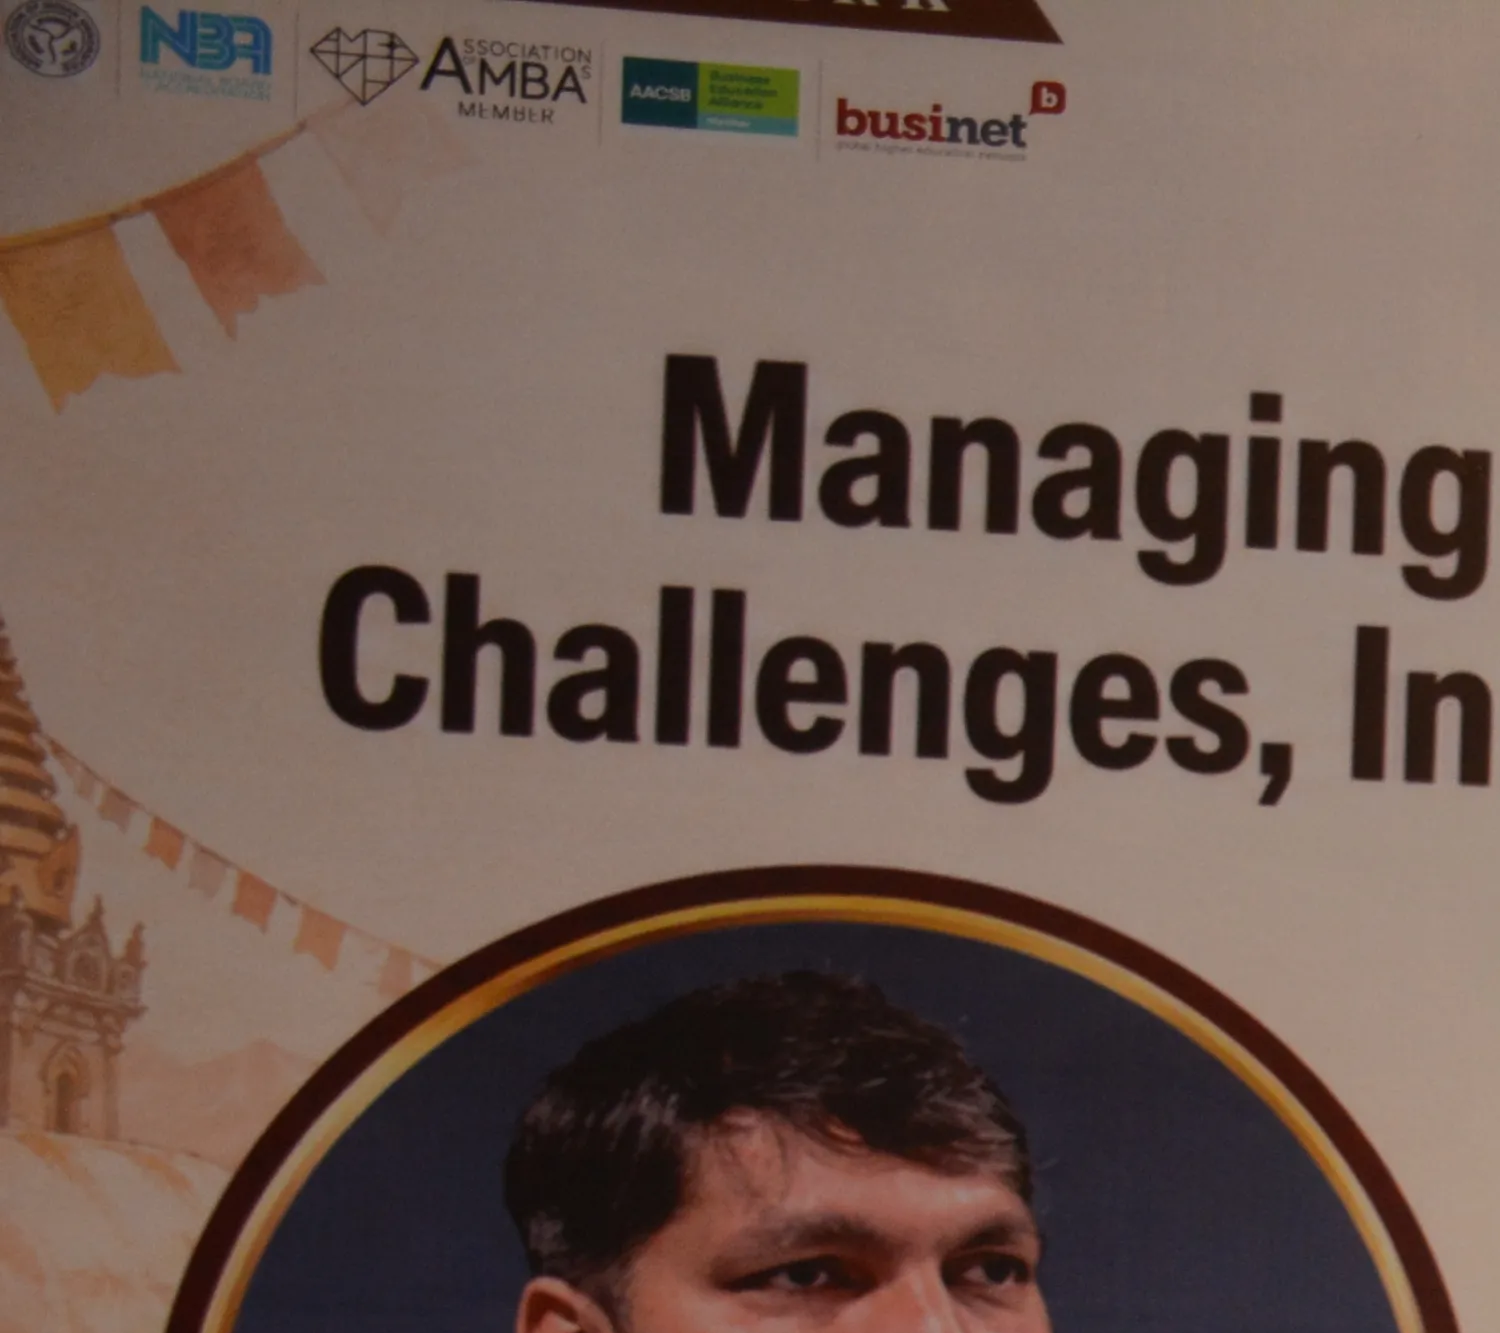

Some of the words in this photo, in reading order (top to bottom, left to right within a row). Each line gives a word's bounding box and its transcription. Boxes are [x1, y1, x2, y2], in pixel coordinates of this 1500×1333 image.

[140, 5, 272, 76] NBA
[630, 83, 692, 103] AACSB
[836, 97, 1028, 149] businet
[660, 354, 1492, 601] Managing
[319, 564, 1292, 805] Challenges,
